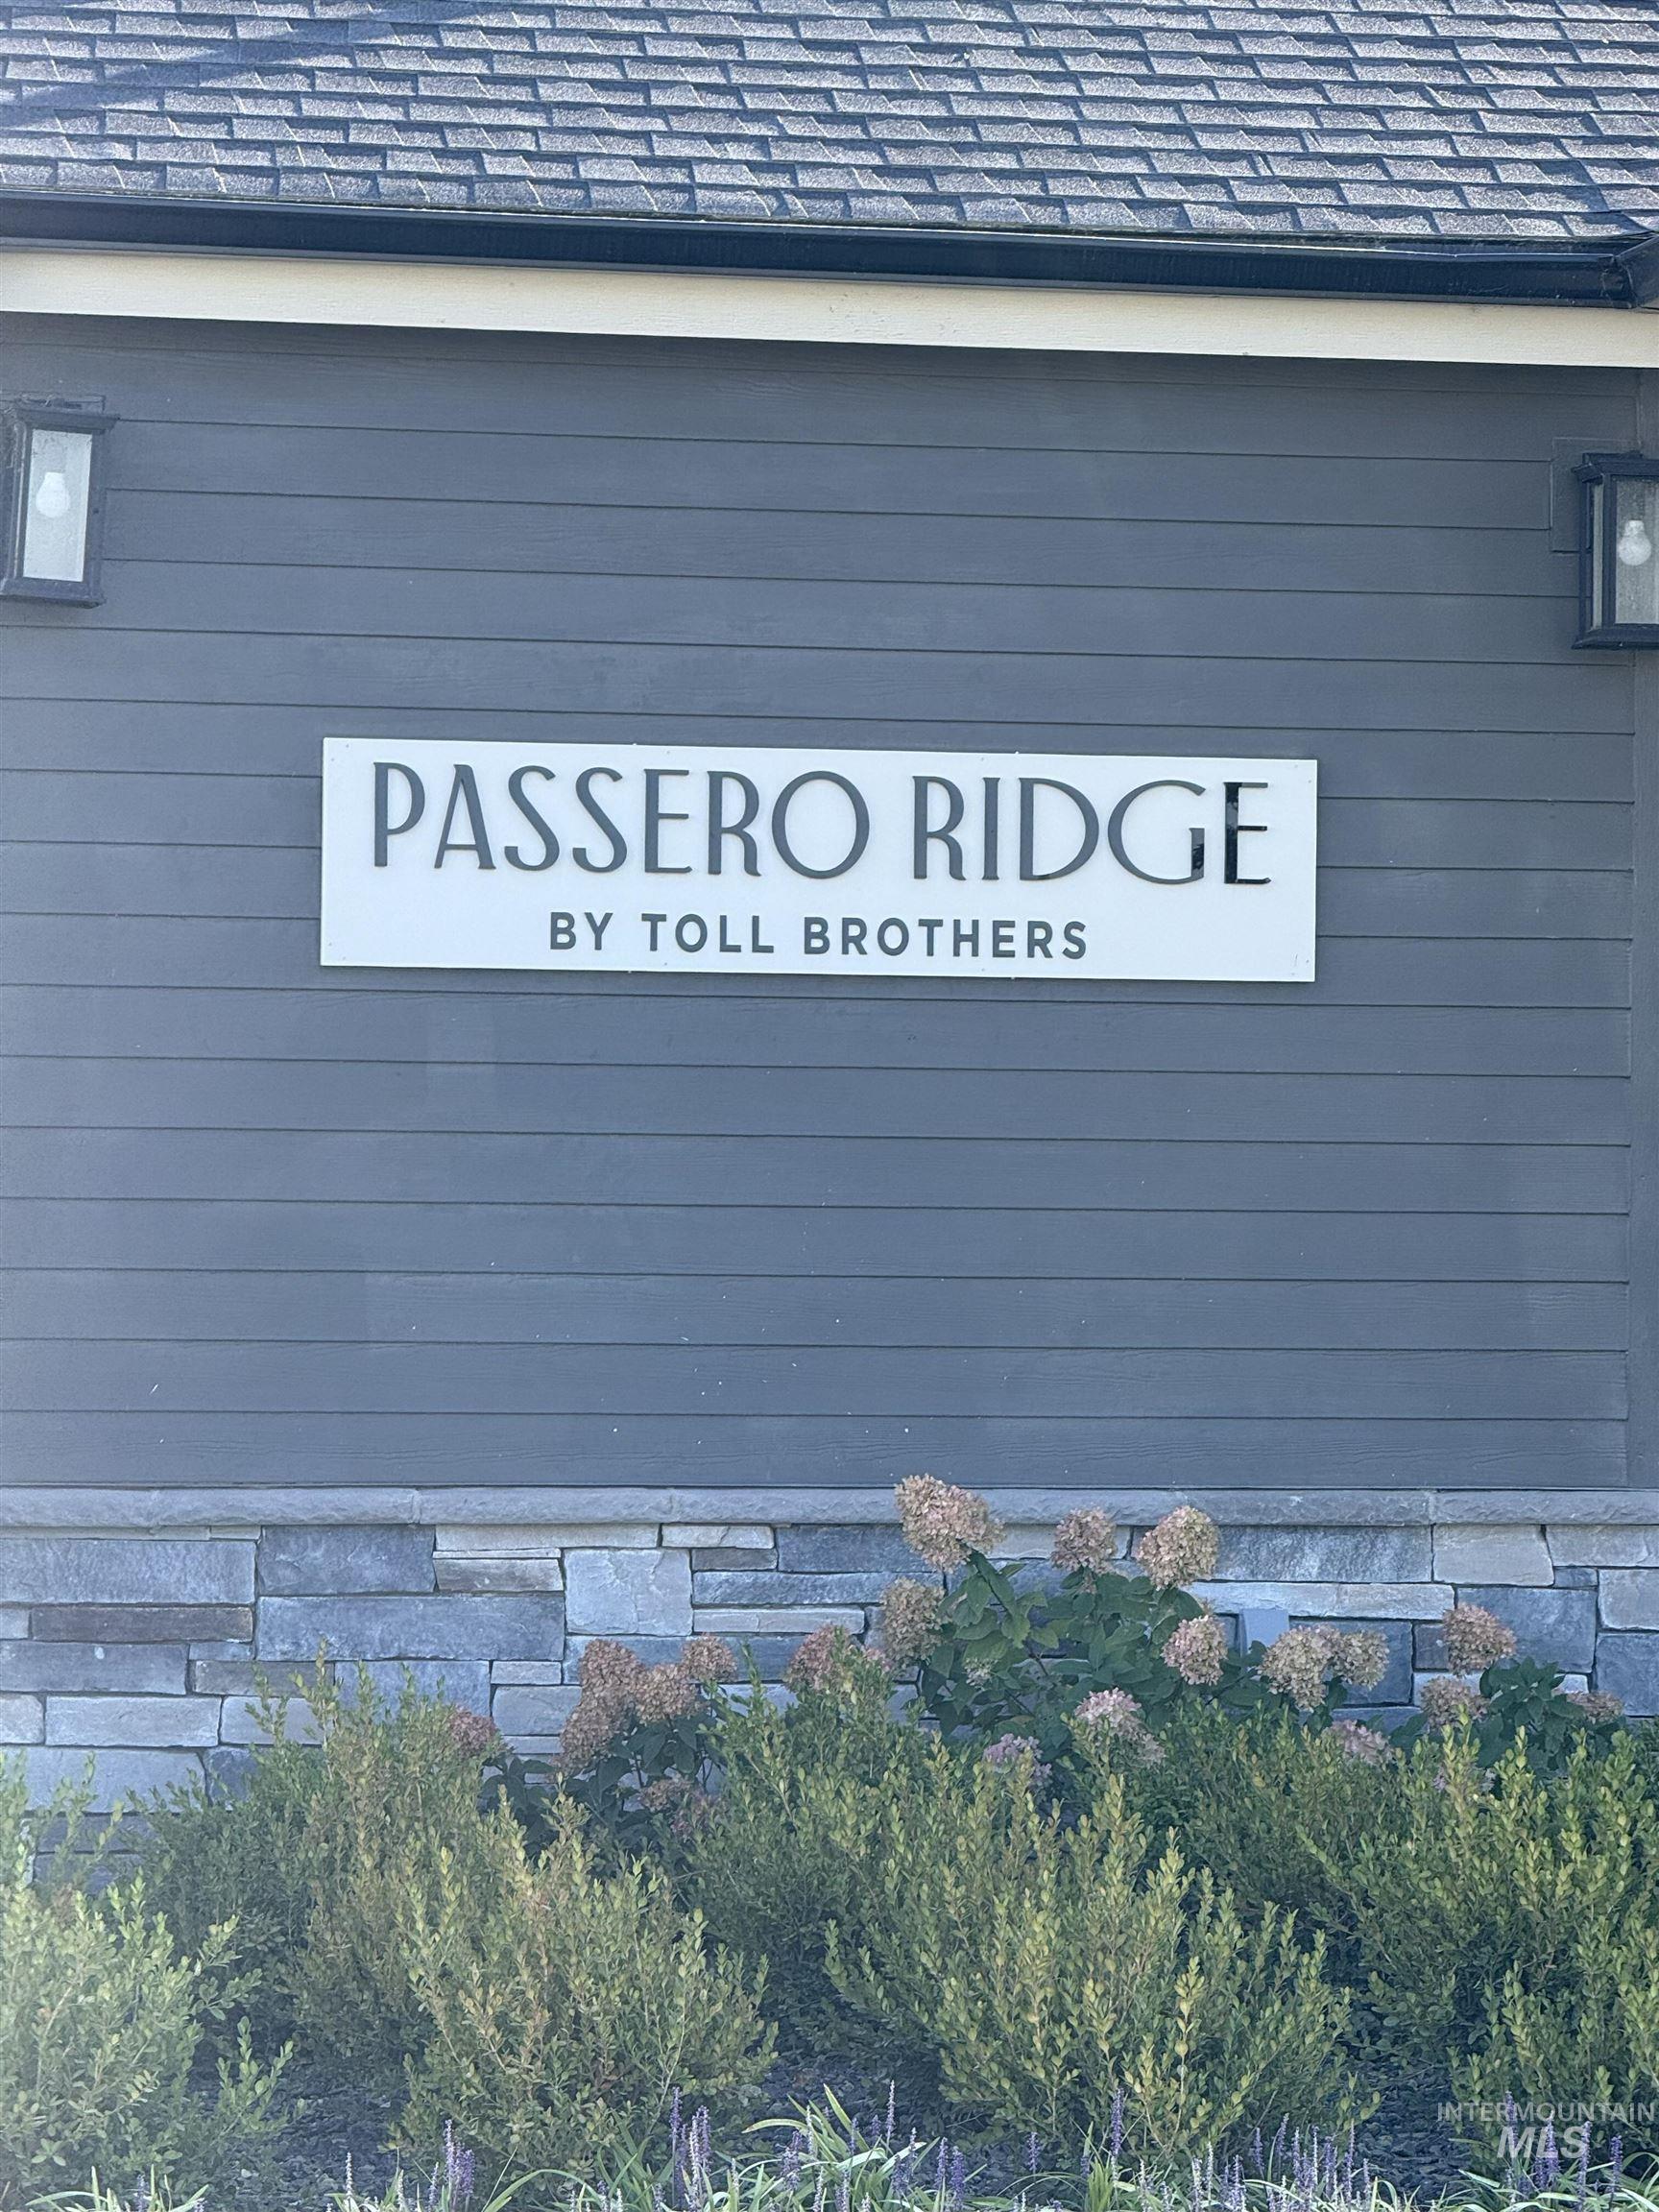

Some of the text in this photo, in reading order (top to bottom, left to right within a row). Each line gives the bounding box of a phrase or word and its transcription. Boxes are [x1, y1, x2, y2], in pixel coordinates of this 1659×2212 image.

[373, 761, 1272, 884] PASSERO RIDGE
[550, 911, 1087, 959] BY TOLL BROTHERS
